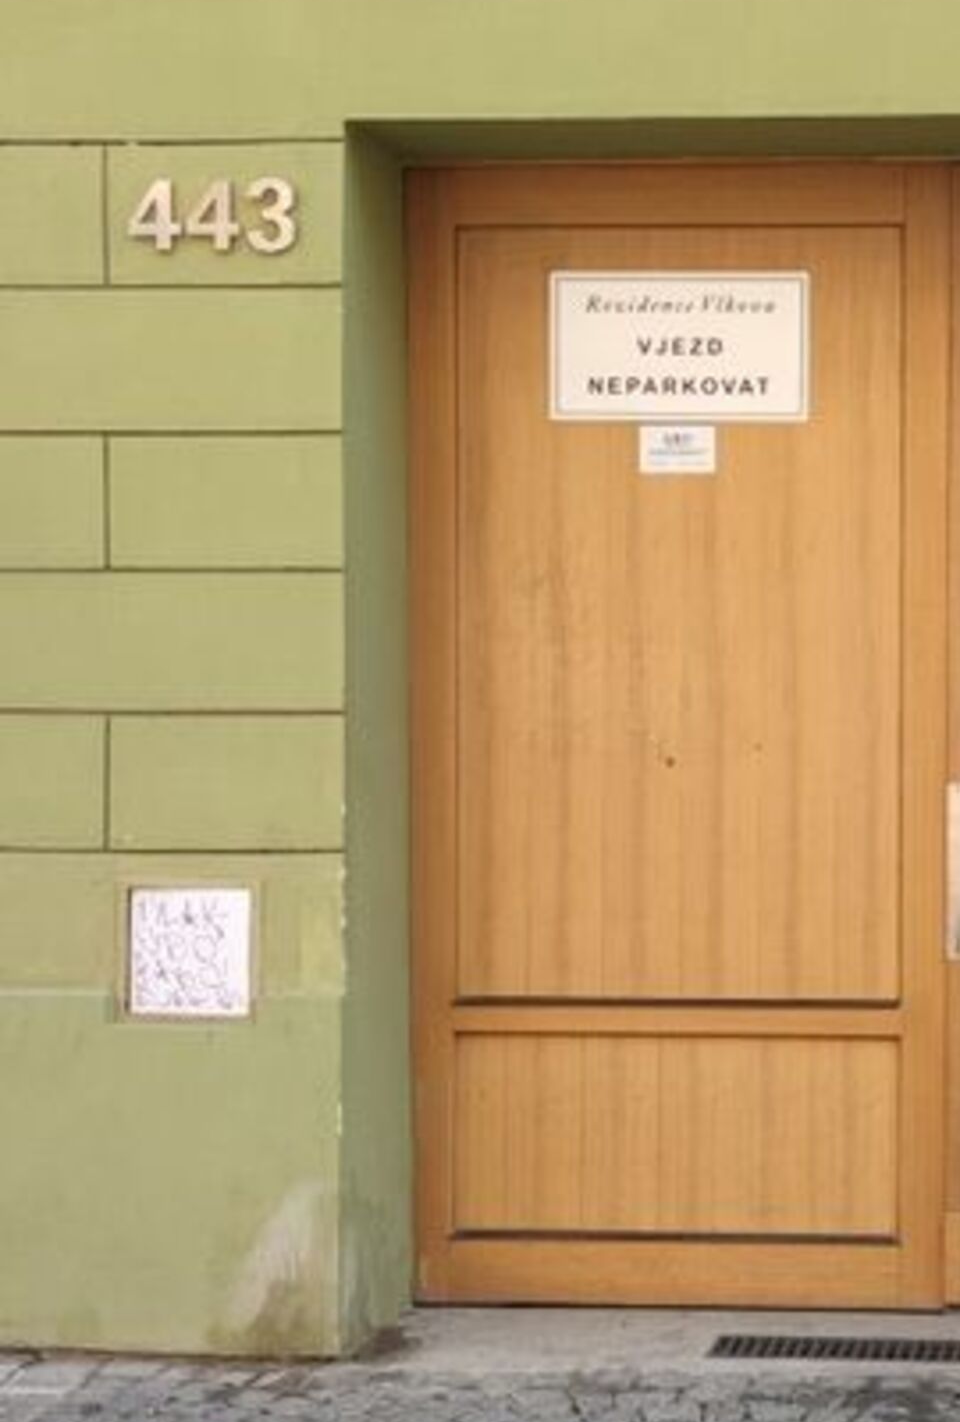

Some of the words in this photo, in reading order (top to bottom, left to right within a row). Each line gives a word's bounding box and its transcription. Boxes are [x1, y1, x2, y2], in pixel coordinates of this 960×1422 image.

[127, 177, 296, 253] 443
[636, 336, 724, 356] VJEZD
[586, 376, 769, 396] NEPARKOVAT
